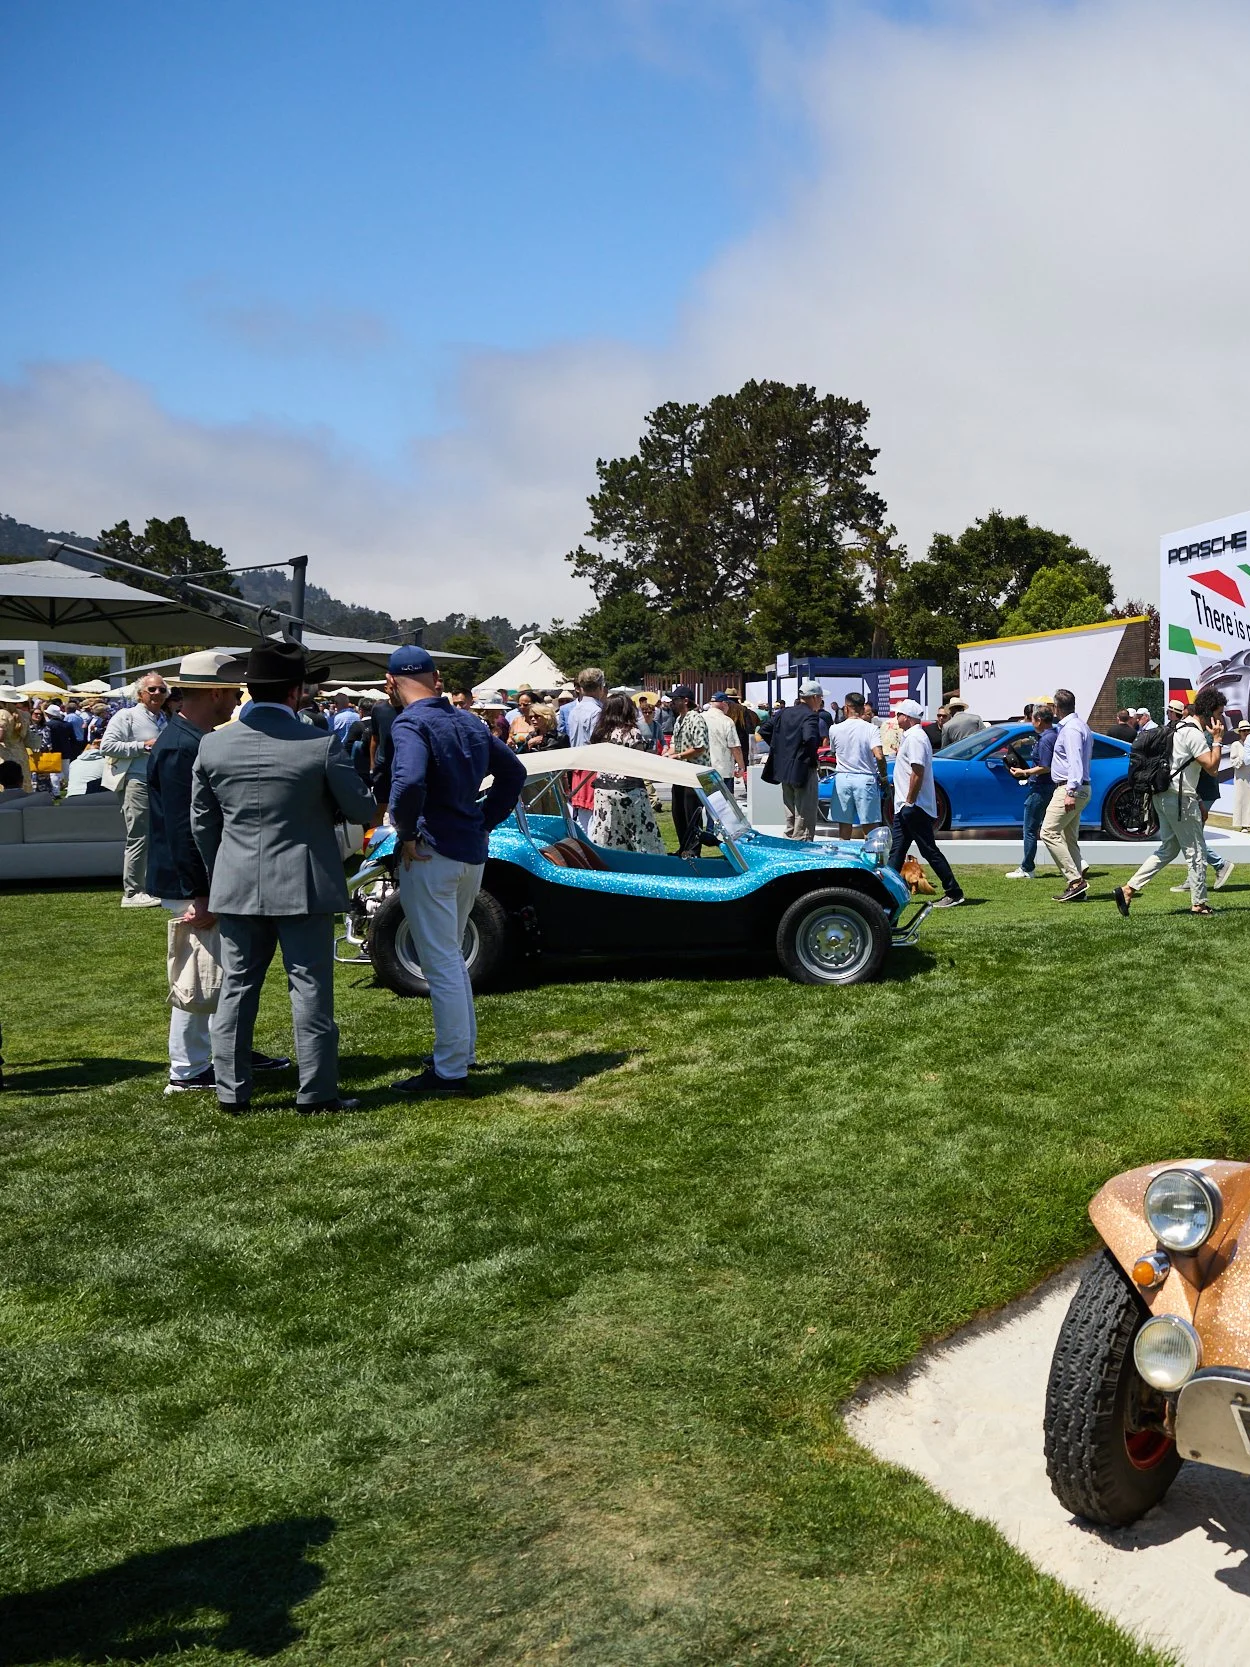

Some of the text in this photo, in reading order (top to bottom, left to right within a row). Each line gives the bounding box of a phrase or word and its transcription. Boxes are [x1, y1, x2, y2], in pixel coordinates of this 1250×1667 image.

[1168, 530, 1247, 564] PORSCHE
[1190, 589, 1234, 636] There
[1234, 611, 1246, 640] is
[968, 660, 996, 680] ACURA
